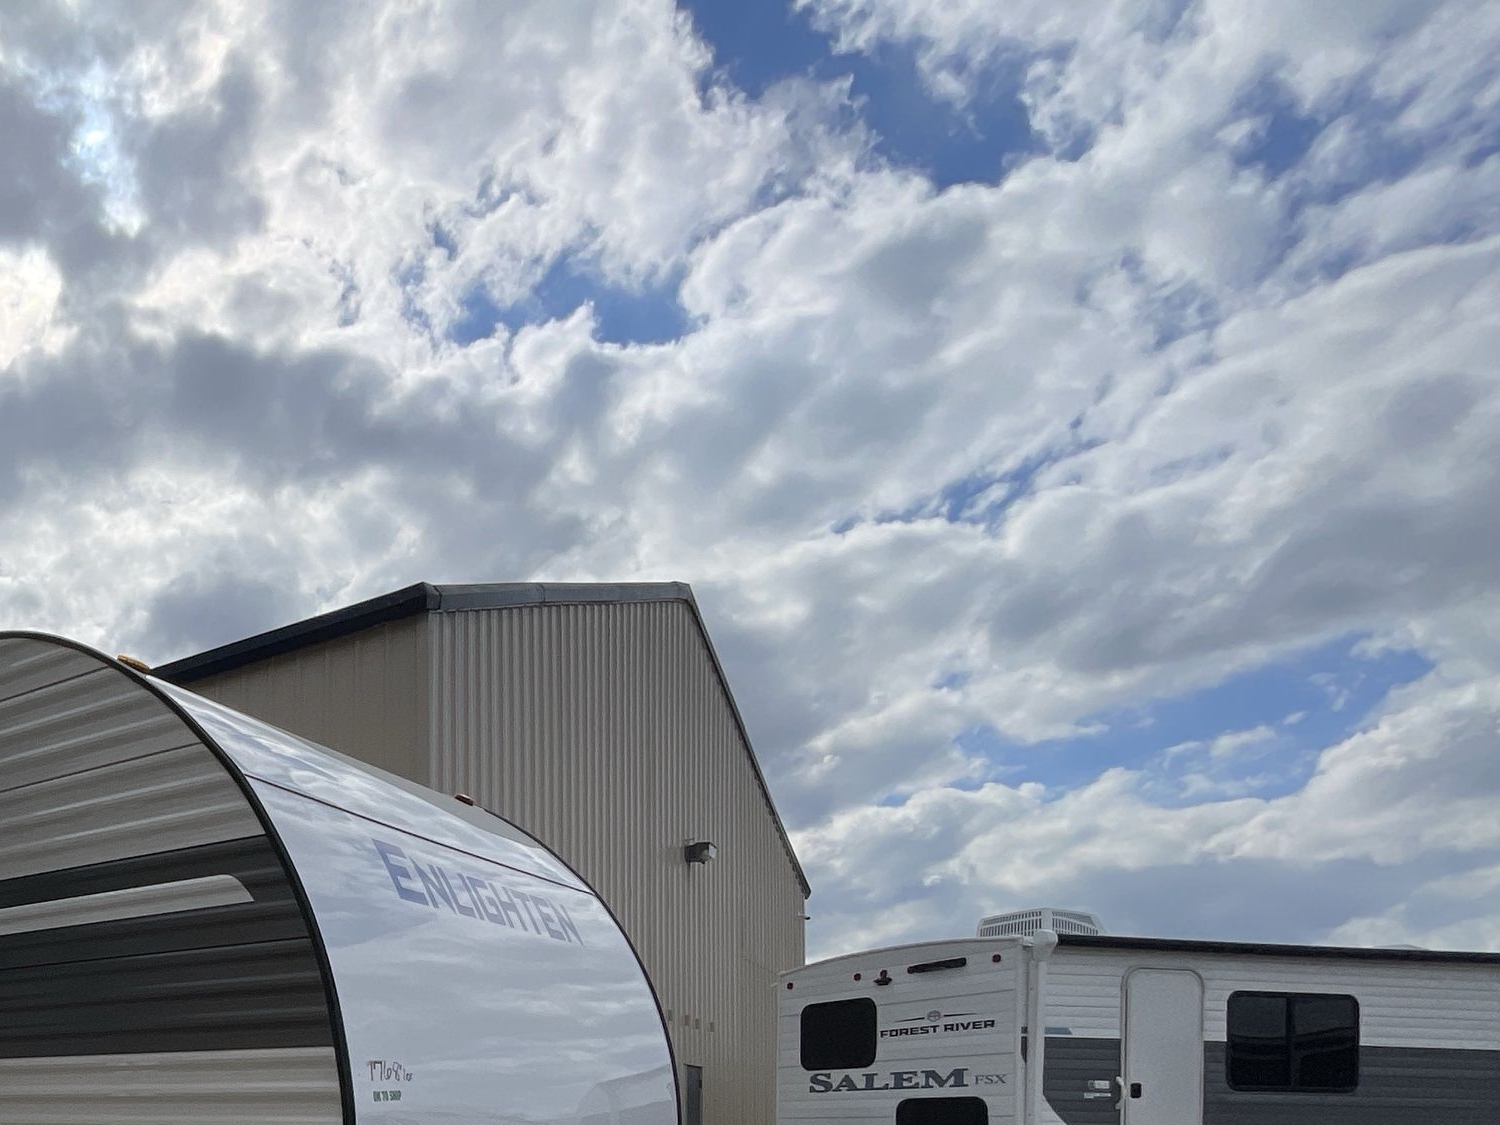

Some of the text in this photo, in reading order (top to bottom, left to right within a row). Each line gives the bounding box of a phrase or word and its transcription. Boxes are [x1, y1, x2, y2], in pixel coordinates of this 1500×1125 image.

[370, 837, 585, 947] ENLIGHTEN
[879, 1019, 996, 1039] FOREST RIVER
[808, 1067, 1008, 1094] SALEM FSX
